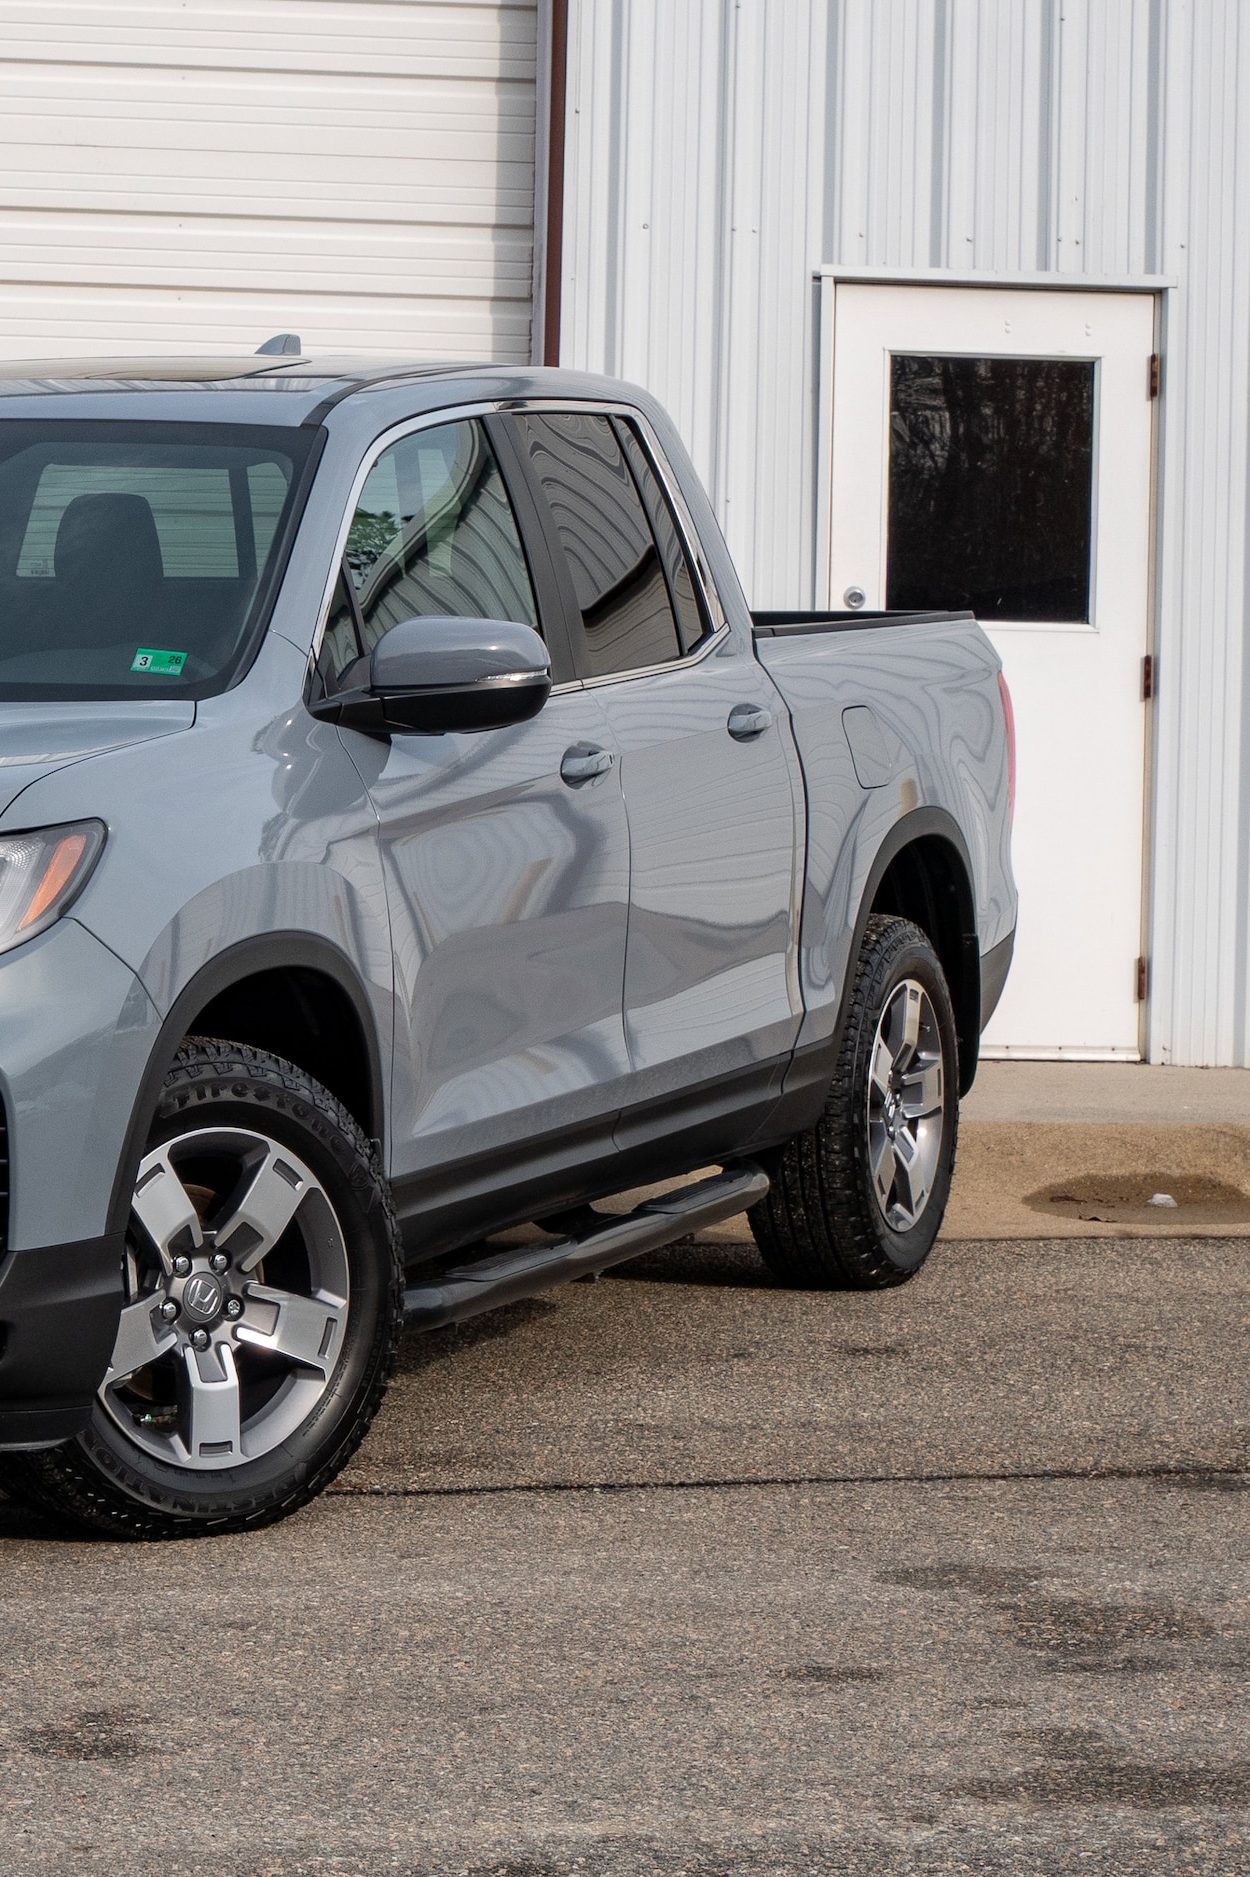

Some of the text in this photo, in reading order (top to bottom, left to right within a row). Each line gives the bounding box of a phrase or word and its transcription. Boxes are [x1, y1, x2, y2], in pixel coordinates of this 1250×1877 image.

[139, 656, 149, 666] 3
[168, 655, 182, 665] 26
[173, 1082, 344, 1154] Firestone
